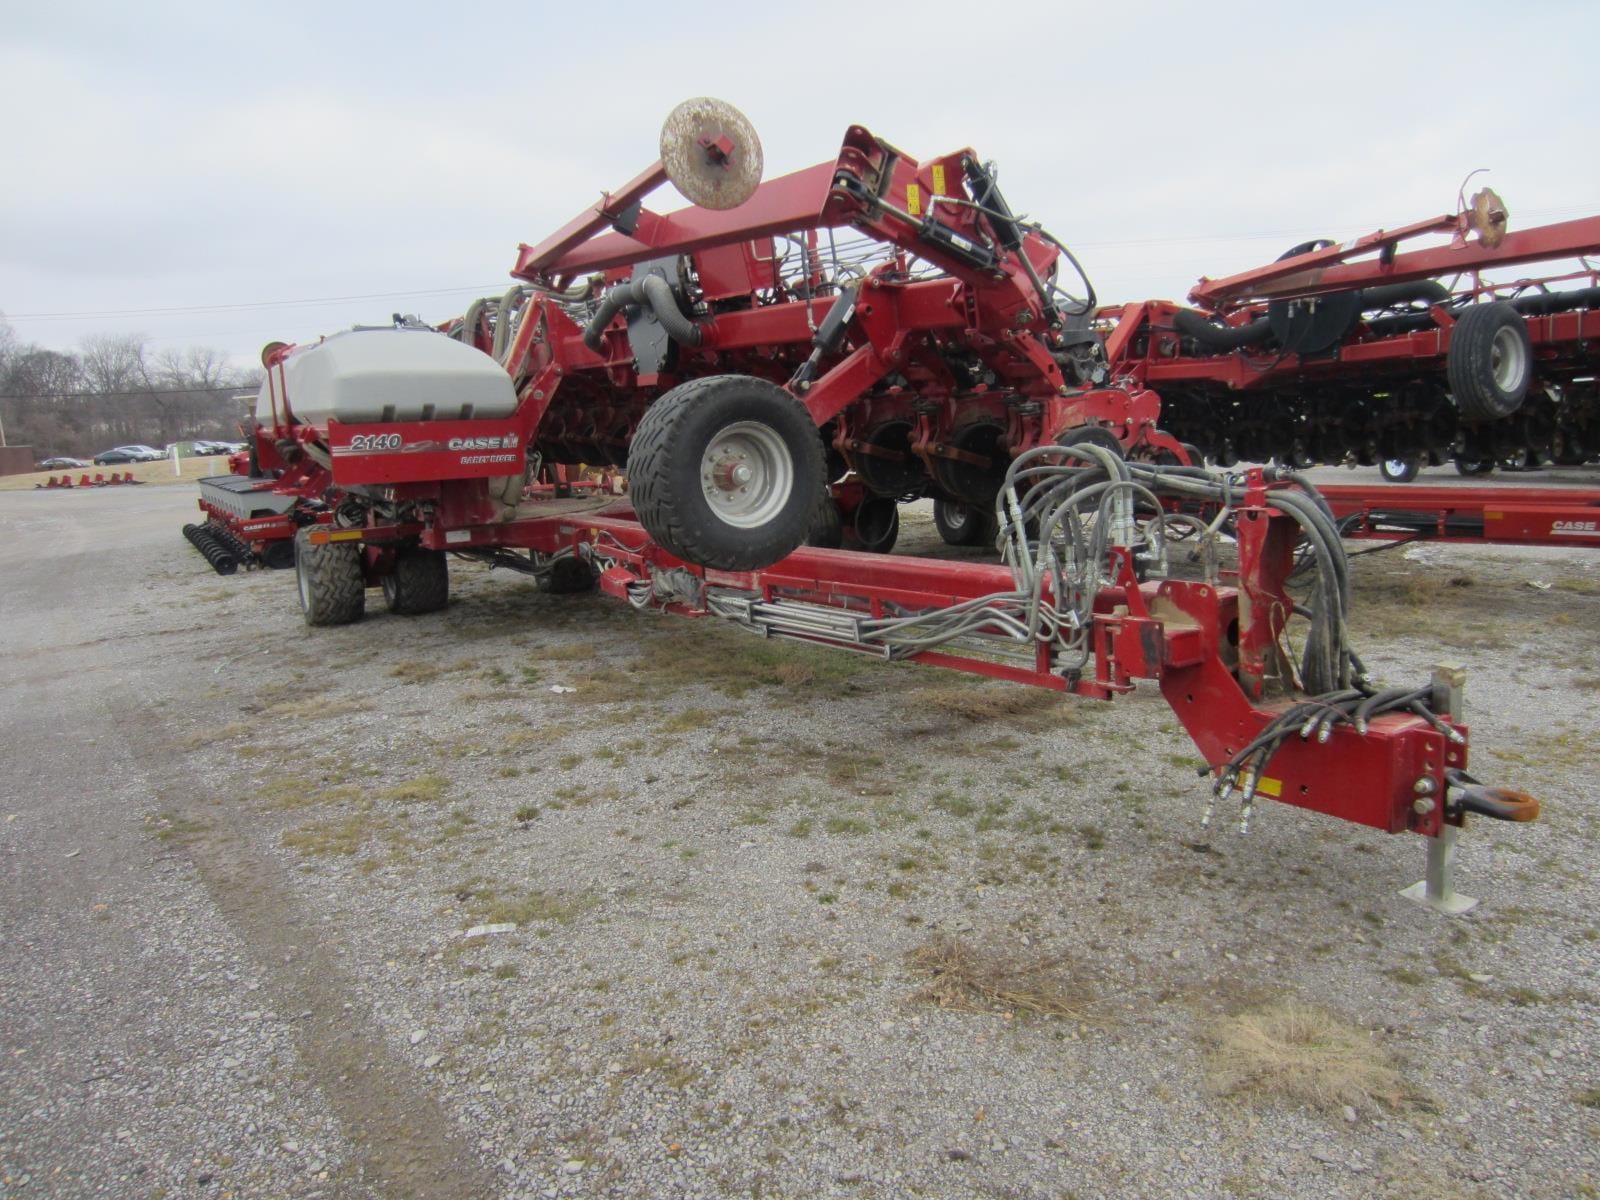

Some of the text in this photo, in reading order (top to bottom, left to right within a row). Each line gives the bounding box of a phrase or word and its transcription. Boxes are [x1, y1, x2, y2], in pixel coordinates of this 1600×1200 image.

[351, 434, 401, 450] 2140
[448, 437, 501, 450] CASE
[1552, 521, 1595, 530] CASE
